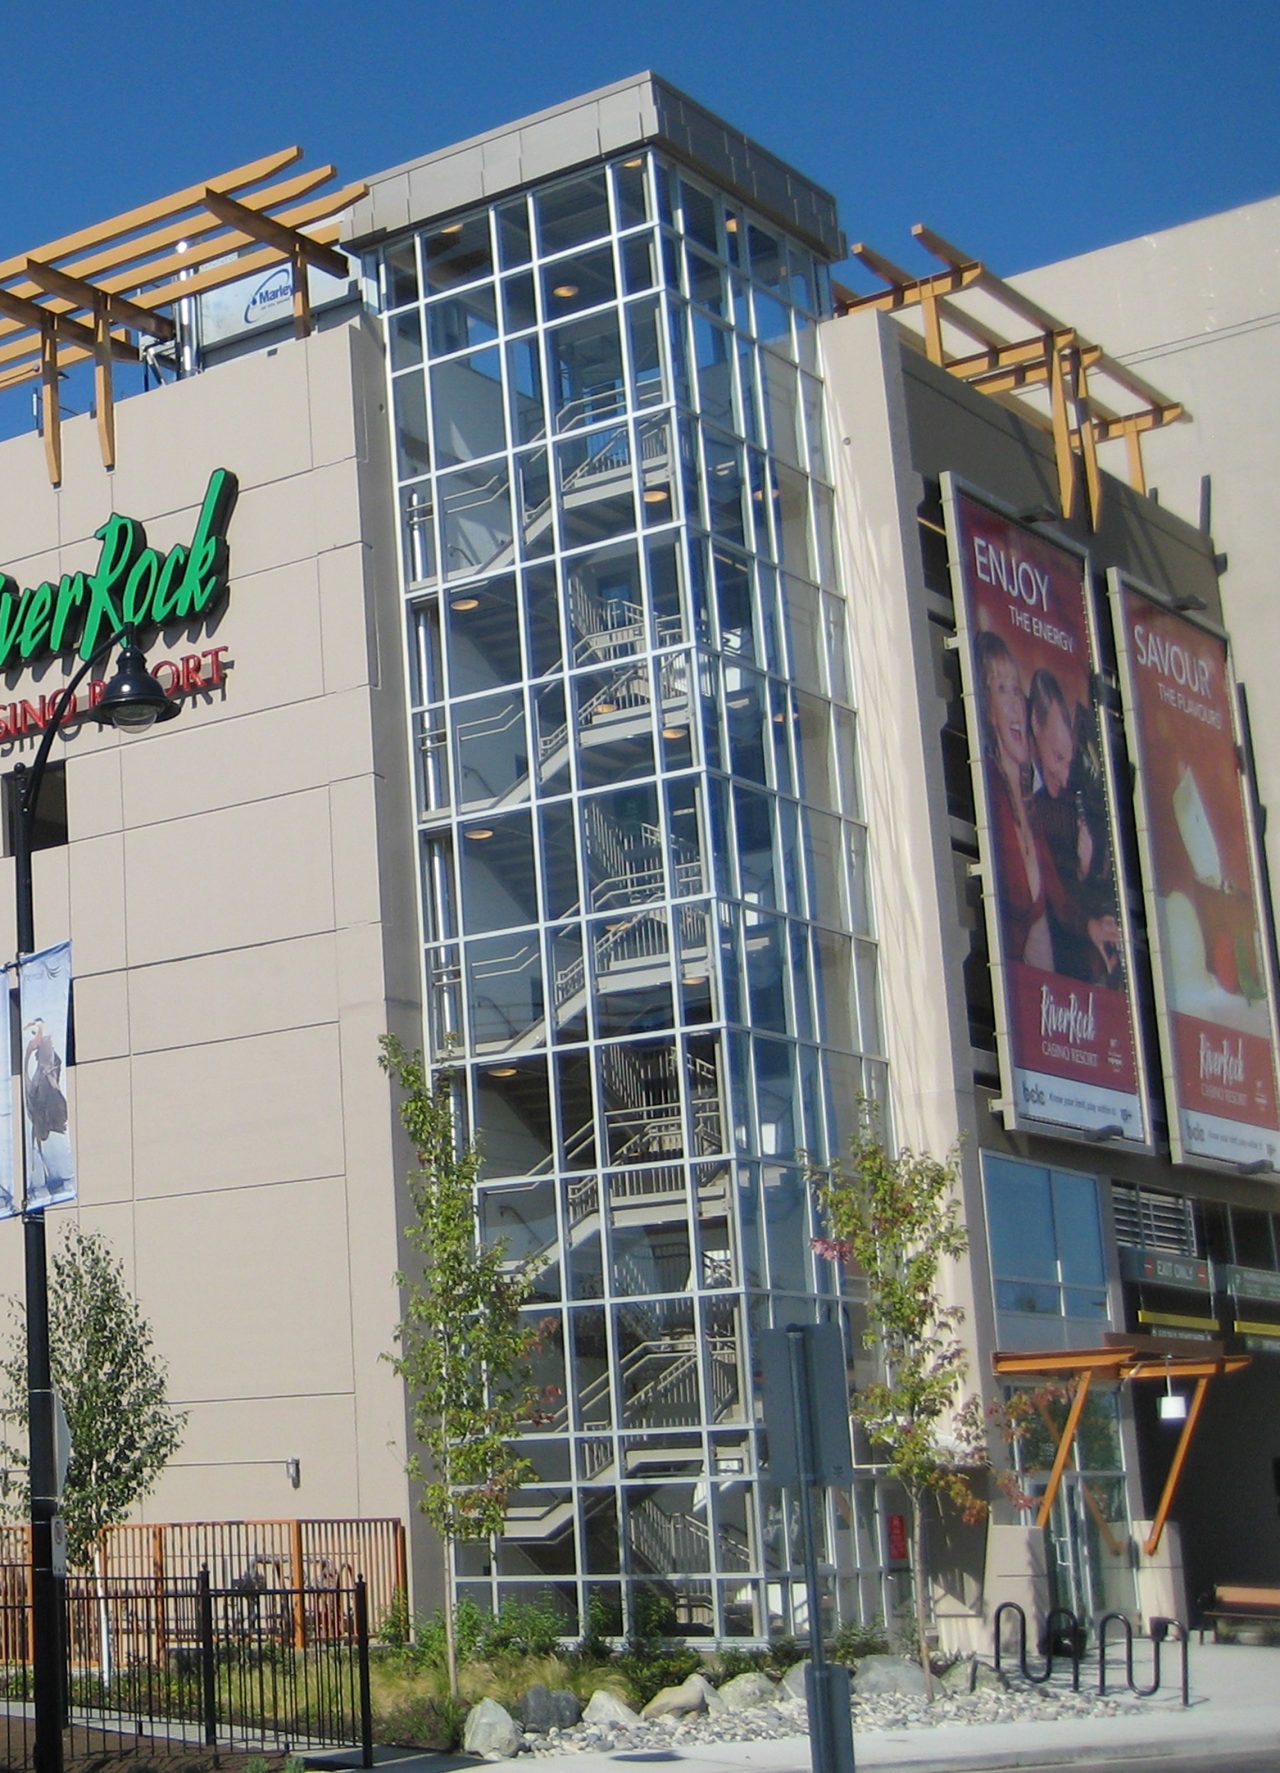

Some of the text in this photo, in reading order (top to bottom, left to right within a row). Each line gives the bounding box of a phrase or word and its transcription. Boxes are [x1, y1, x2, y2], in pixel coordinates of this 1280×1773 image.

[973, 535, 1049, 612] ENJOY
[1008, 604, 1073, 654] THE ENERGY
[87, 645, 230, 703] RORT
[1134, 624, 1212, 699] SAVOUR
[1156, 1260, 1173, 1277] EXIT
